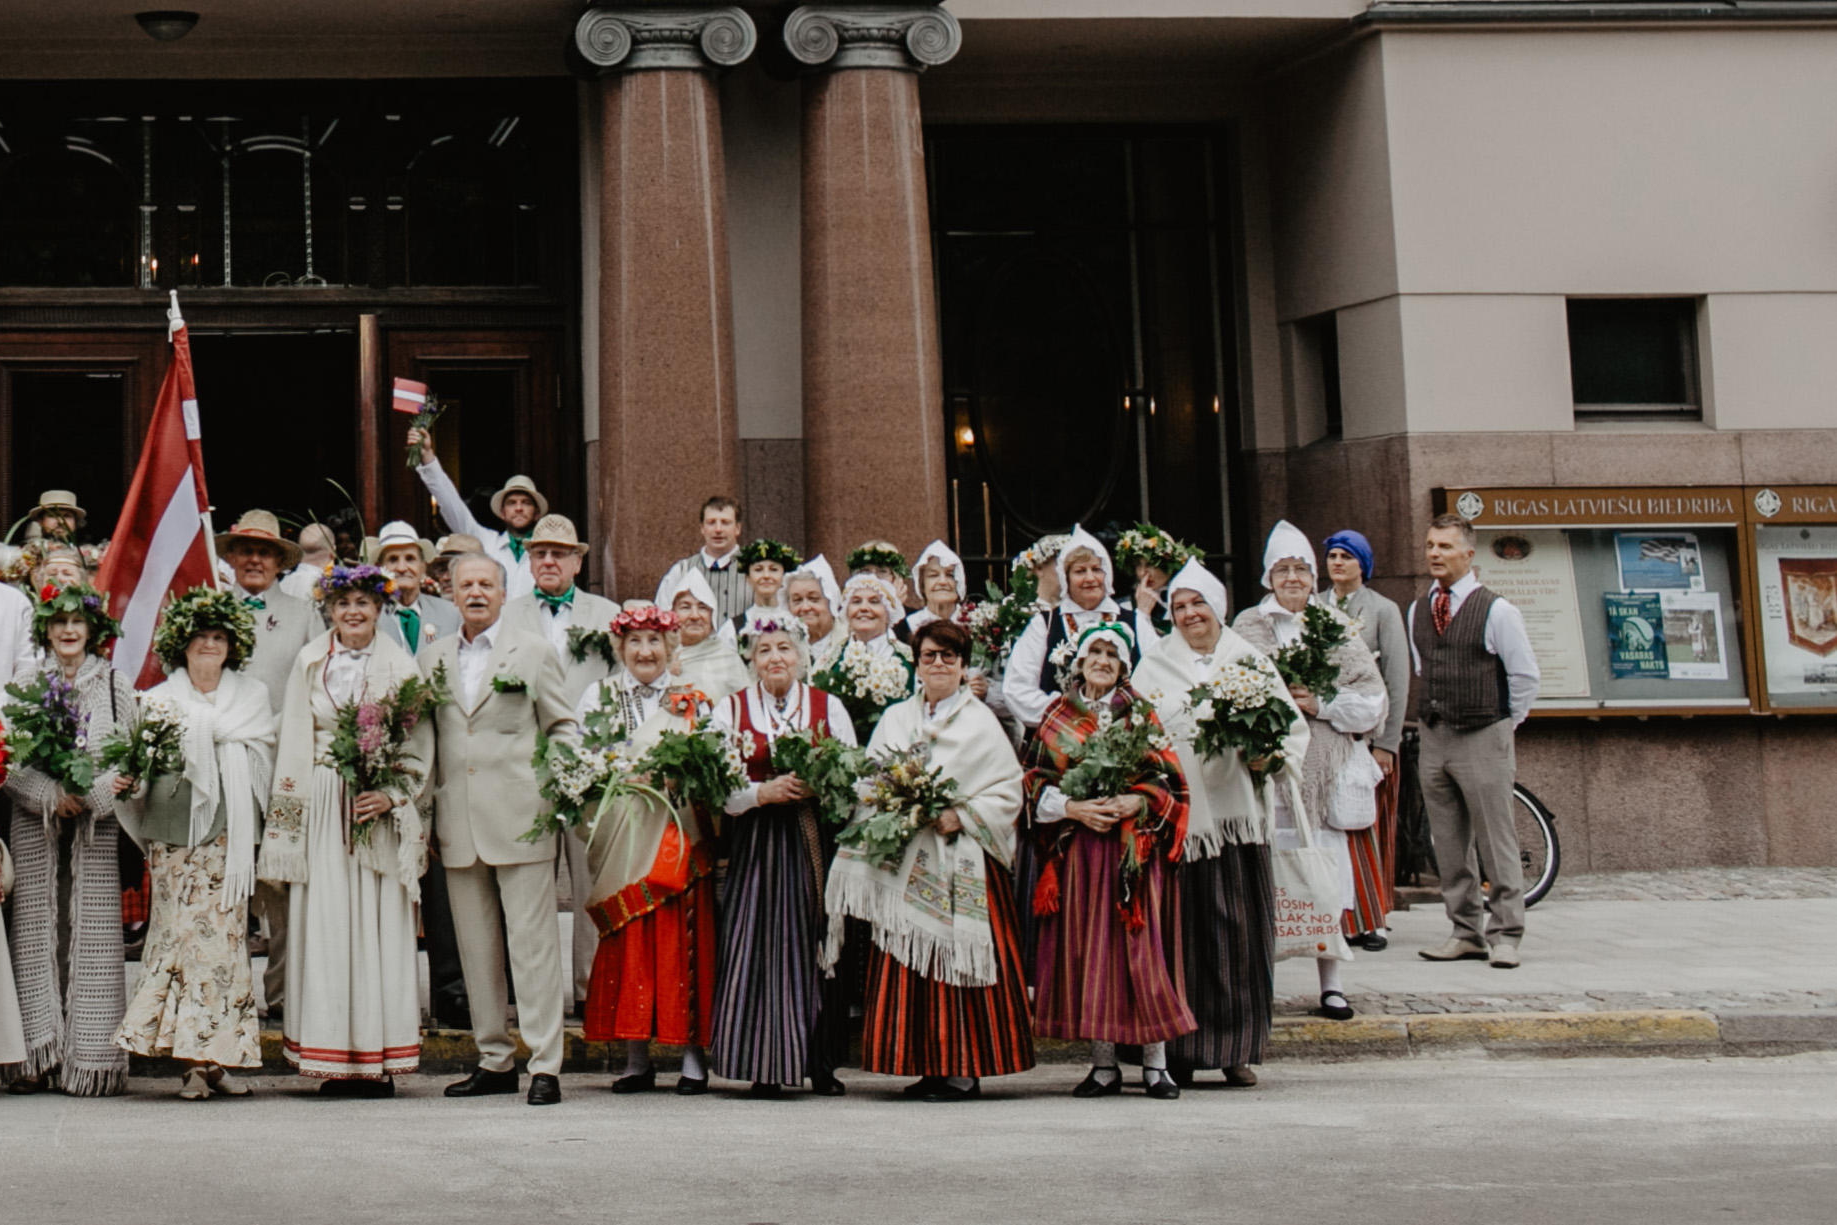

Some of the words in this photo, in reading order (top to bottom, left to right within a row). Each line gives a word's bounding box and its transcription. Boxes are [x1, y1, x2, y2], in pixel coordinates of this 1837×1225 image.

[1494, 498, 1549, 516] RĪGAS
[1554, 496, 1641, 516] LATVIEŠU
[1648, 497, 1734, 514] BIEDRĪBA
[1792, 496, 1837, 513] RĪGA
[1765, 585, 1783, 619] 1873
[1619, 651, 1654, 660] VASARAS
[1640, 661, 1665, 670] NAKTS
[1275, 899, 1314, 911] JOSIM
[1310, 913, 1332, 924] NO
[1305, 924, 1340, 936] SIRDS
